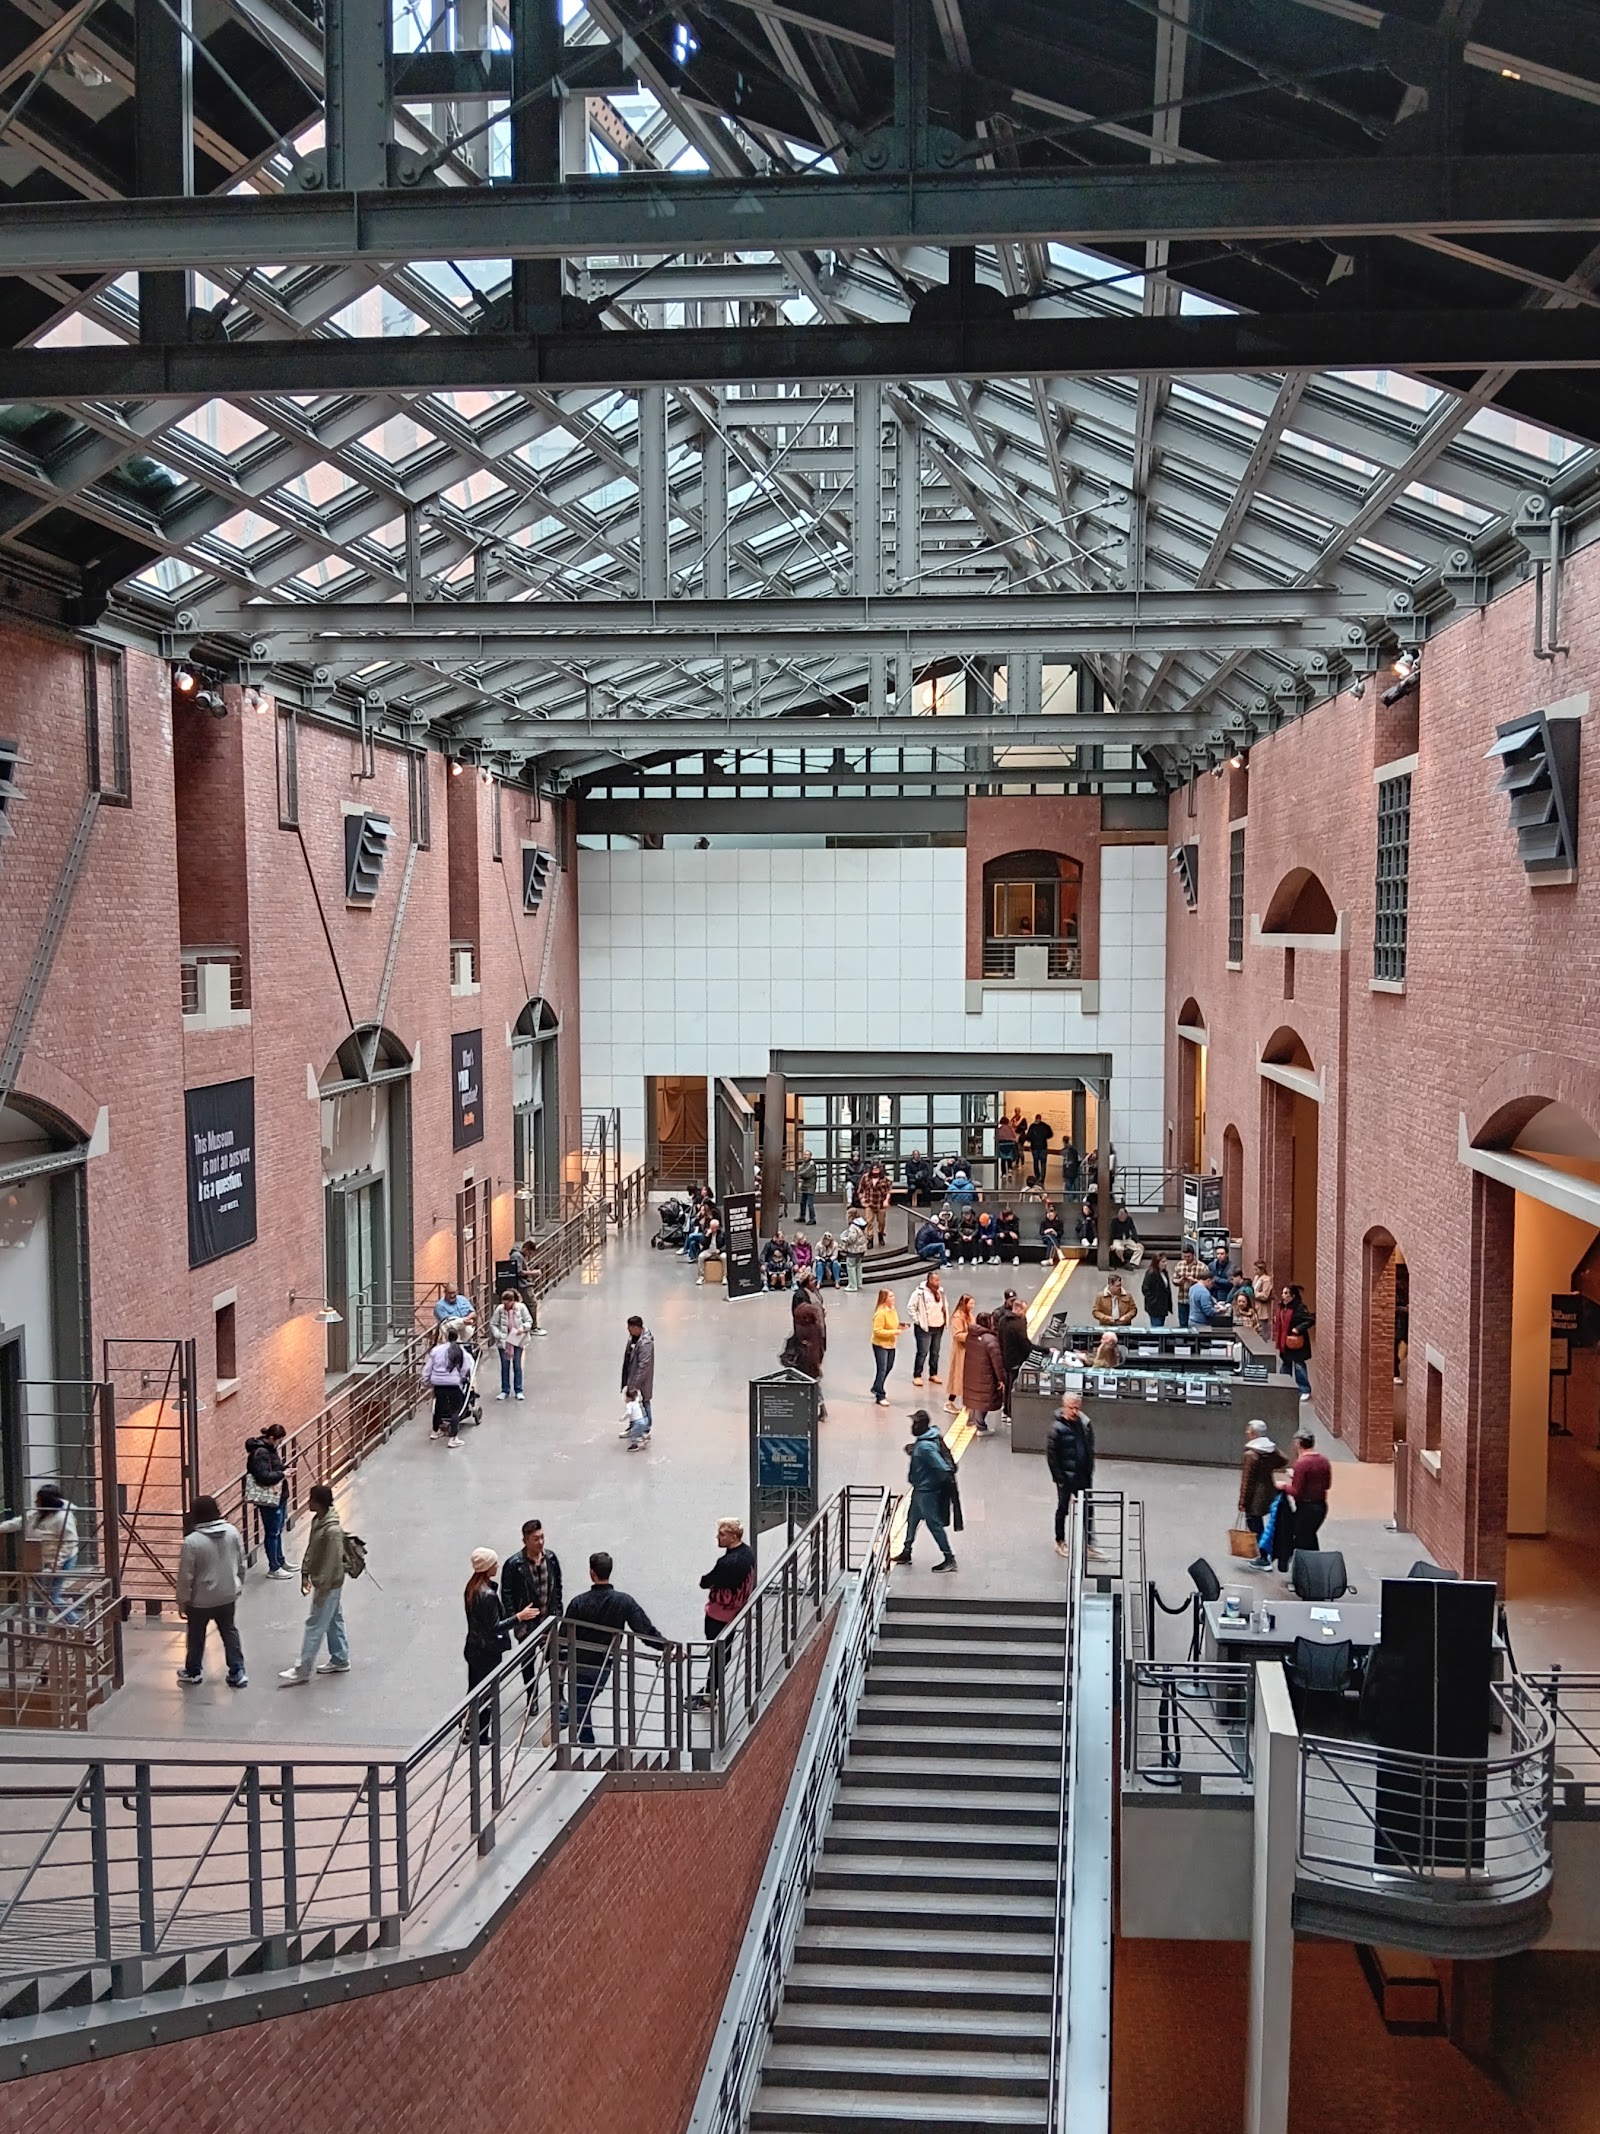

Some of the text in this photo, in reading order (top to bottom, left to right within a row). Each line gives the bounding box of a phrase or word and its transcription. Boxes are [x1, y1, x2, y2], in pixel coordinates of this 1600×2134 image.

[194, 1130, 234, 1156] This Museum
[203, 1156, 209, 1177] is
[209, 1154, 220, 1175] not
[220, 1154, 229, 1171] an
[203, 1180, 210, 1200] is
[210, 1182, 215, 1198] a
